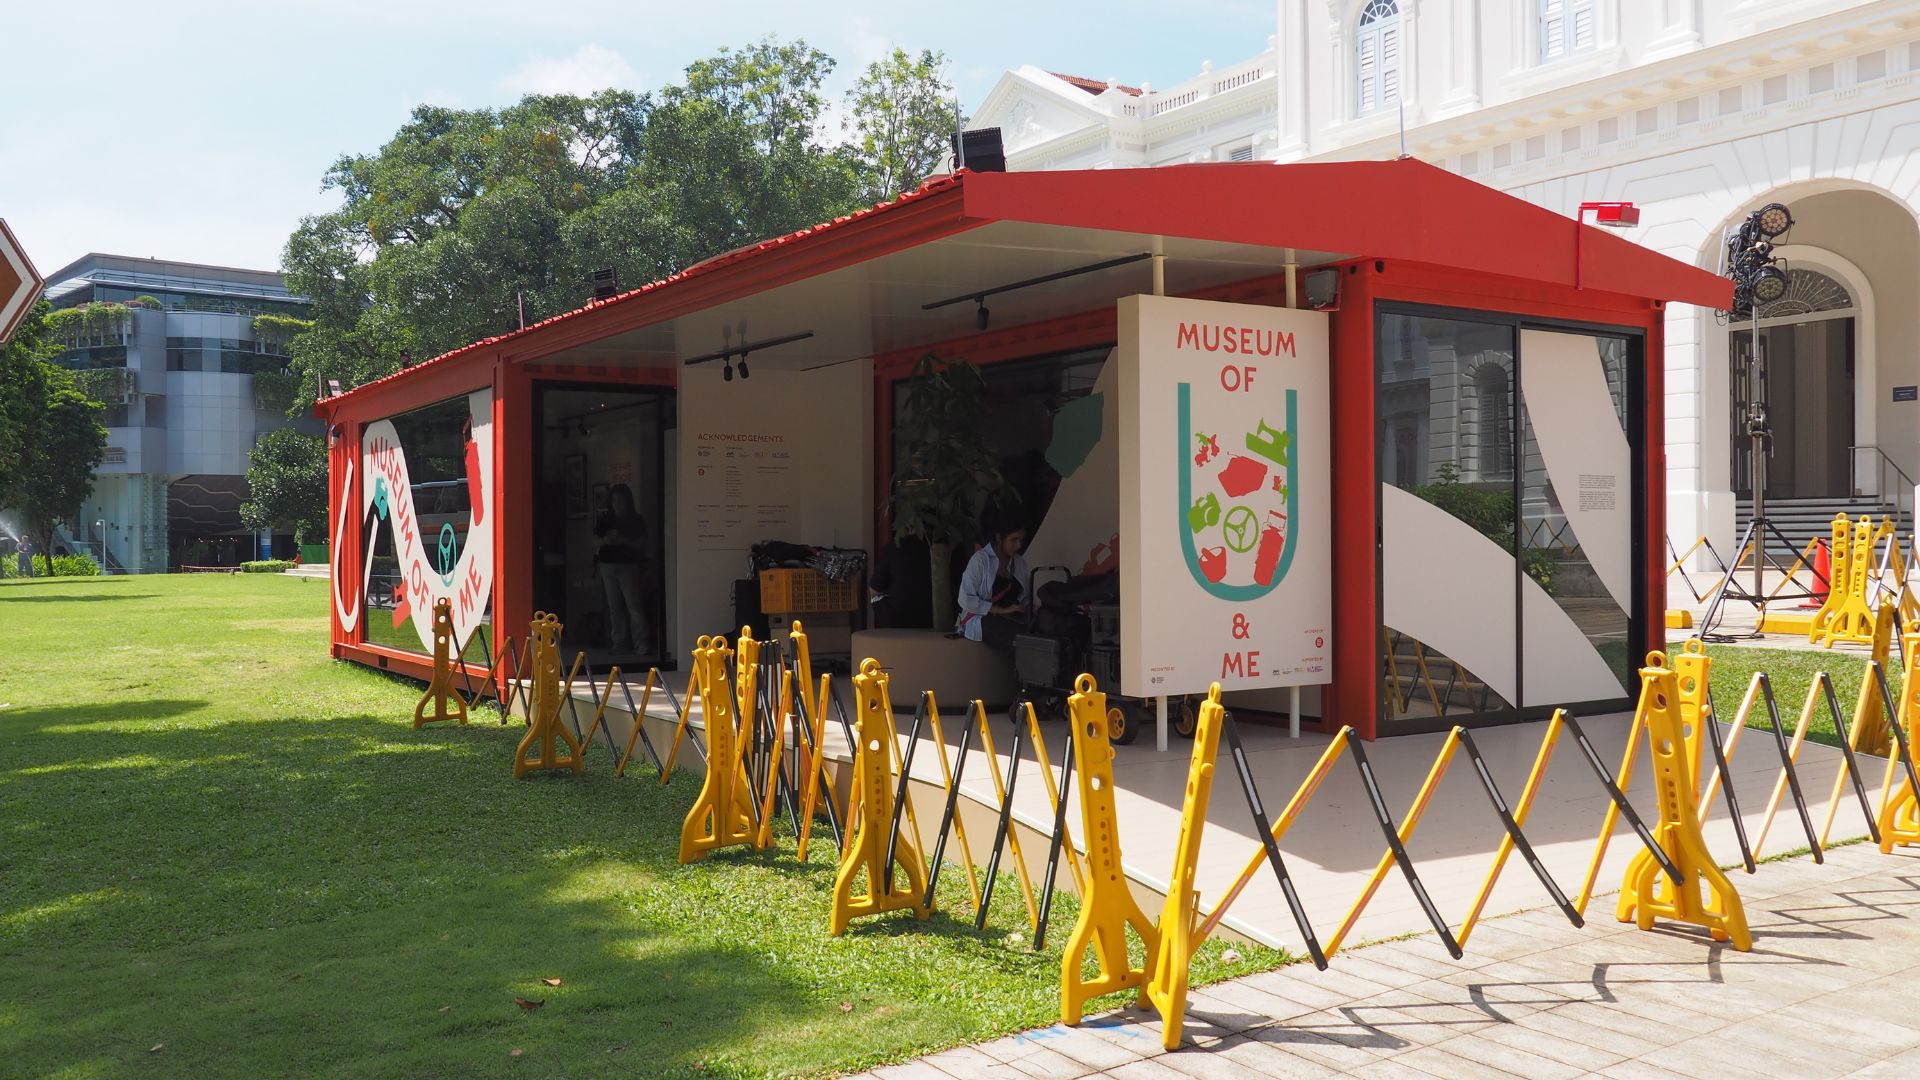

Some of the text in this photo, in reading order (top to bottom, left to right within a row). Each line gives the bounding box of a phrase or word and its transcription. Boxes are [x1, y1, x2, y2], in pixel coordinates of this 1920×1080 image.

[1177, 322, 1296, 358] MUSEUM
[1221, 365, 1257, 392] OF
[698, 433, 784, 442] ACKNOWLEDGEMENTS
[370, 436, 429, 612] MUSEUM OF
[460, 554, 483, 627] ME
[1232, 612, 1250, 640] &
[1222, 651, 1260, 679] ME
